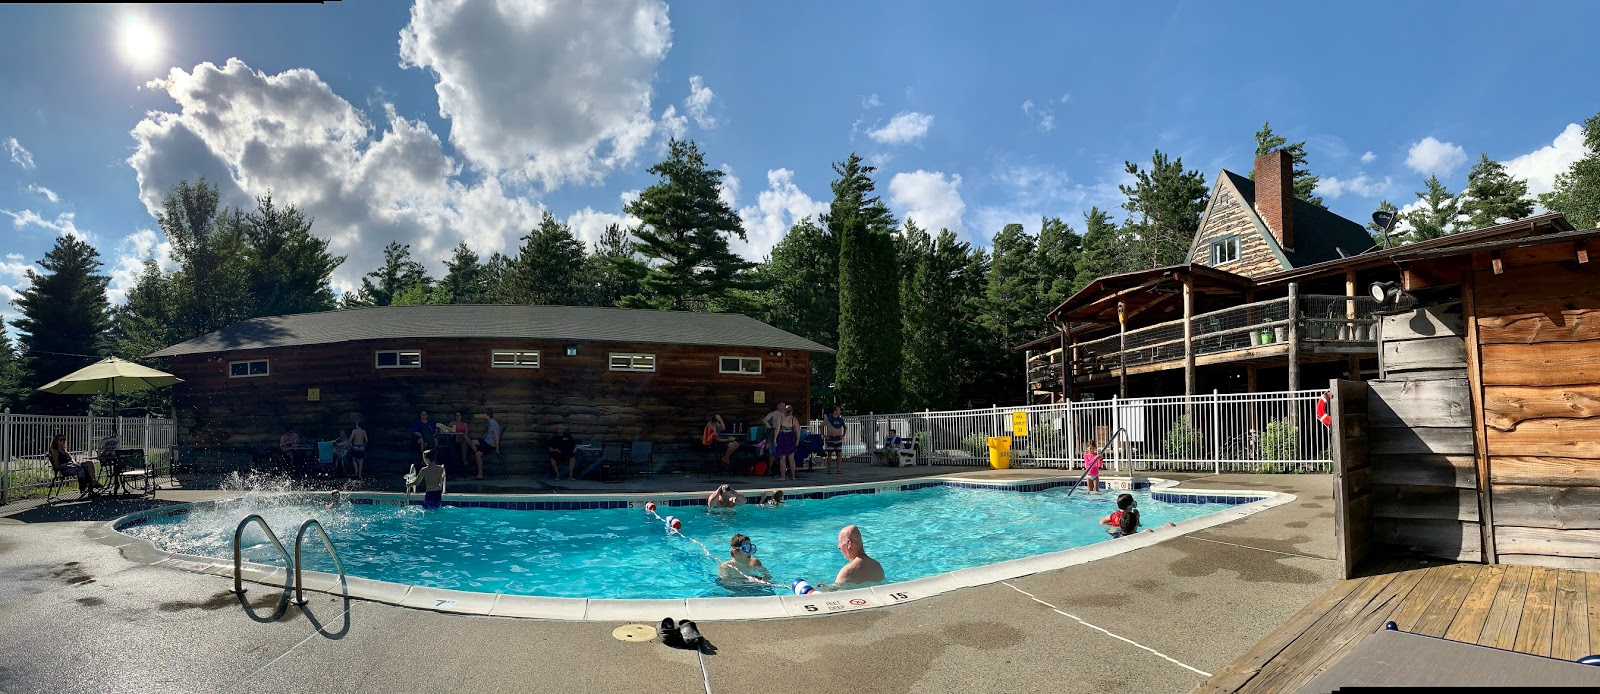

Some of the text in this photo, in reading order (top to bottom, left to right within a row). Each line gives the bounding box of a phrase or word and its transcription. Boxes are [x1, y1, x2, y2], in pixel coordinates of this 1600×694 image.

[628, 501, 634, 509] 5
[435, 599, 447, 607] 7
[804, 604, 819, 612] 5
